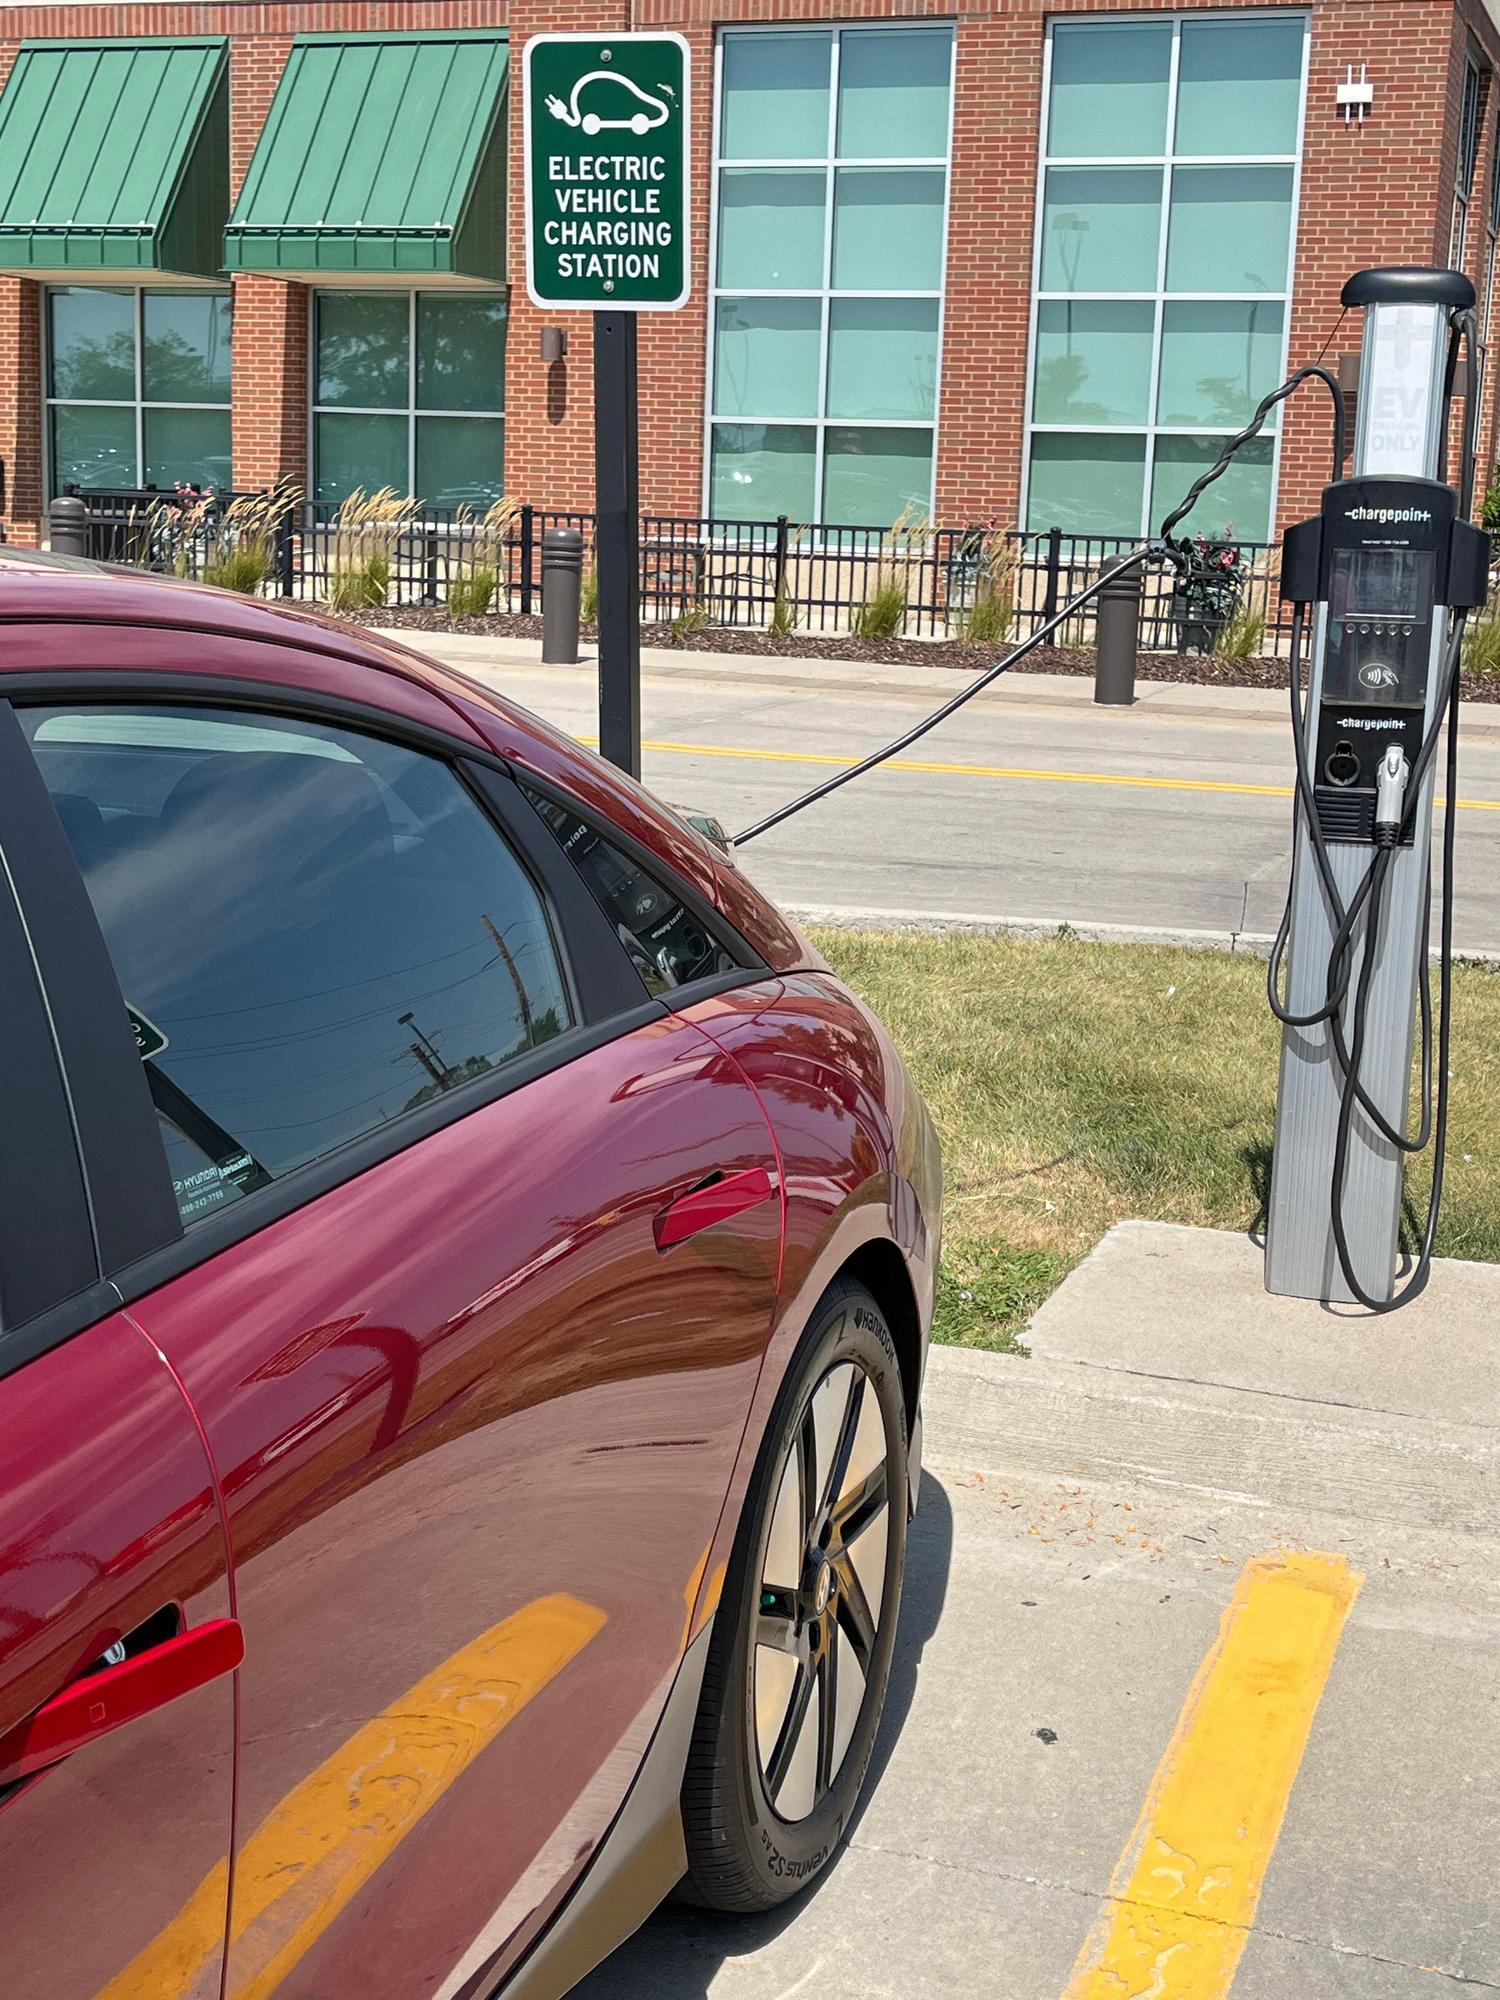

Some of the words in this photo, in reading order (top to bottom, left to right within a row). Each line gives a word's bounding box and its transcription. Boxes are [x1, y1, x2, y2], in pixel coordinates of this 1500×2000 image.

[548, 156, 666, 181] ELECTRIC
[555, 188, 661, 214] VEHICLE
[544, 221, 672, 246] CHARGING
[557, 253, 660, 279] STATION
[1374, 386, 1425, 418] EV
[1370, 434, 1421, 451] ONLY
[183, 1167, 218, 1189] HYUNDAI
